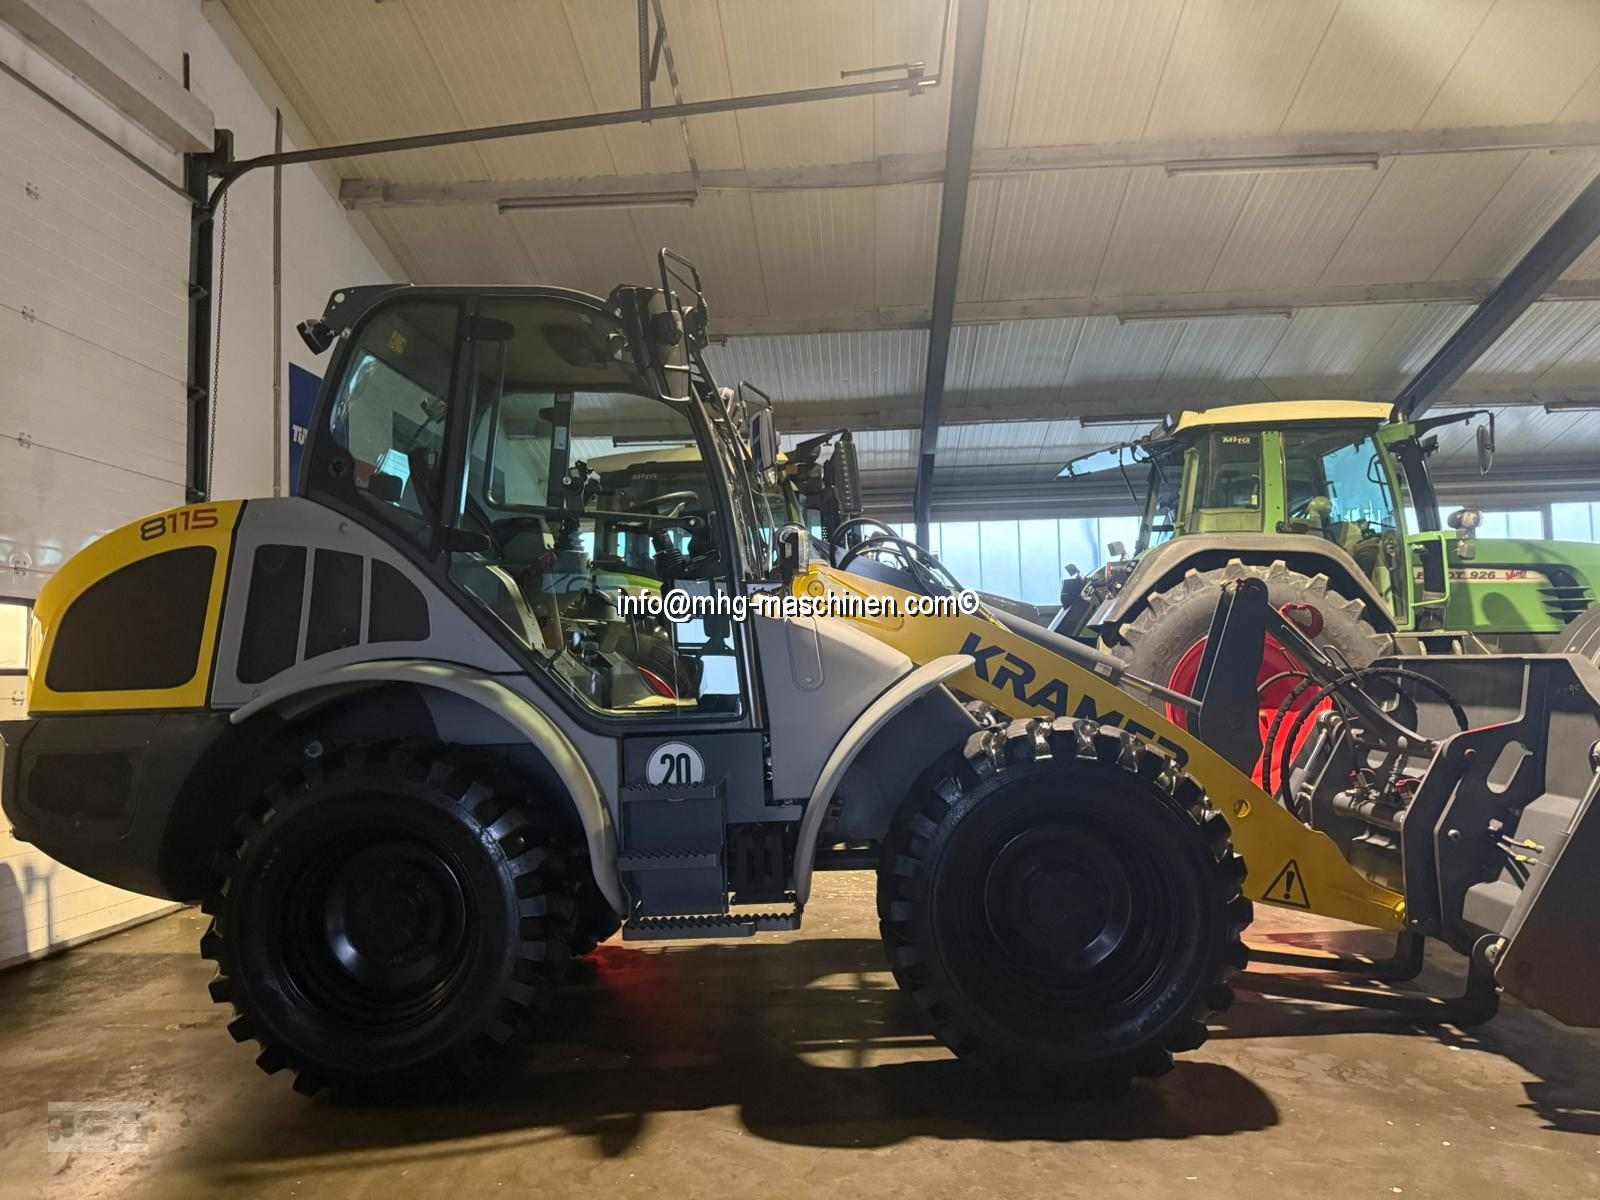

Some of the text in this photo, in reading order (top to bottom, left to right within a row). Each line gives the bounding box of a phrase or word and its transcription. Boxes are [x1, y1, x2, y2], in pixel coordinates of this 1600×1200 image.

[141, 508, 218, 541] 8115
[1470, 570, 1497, 580] 926
[660, 753, 691, 785] 20
